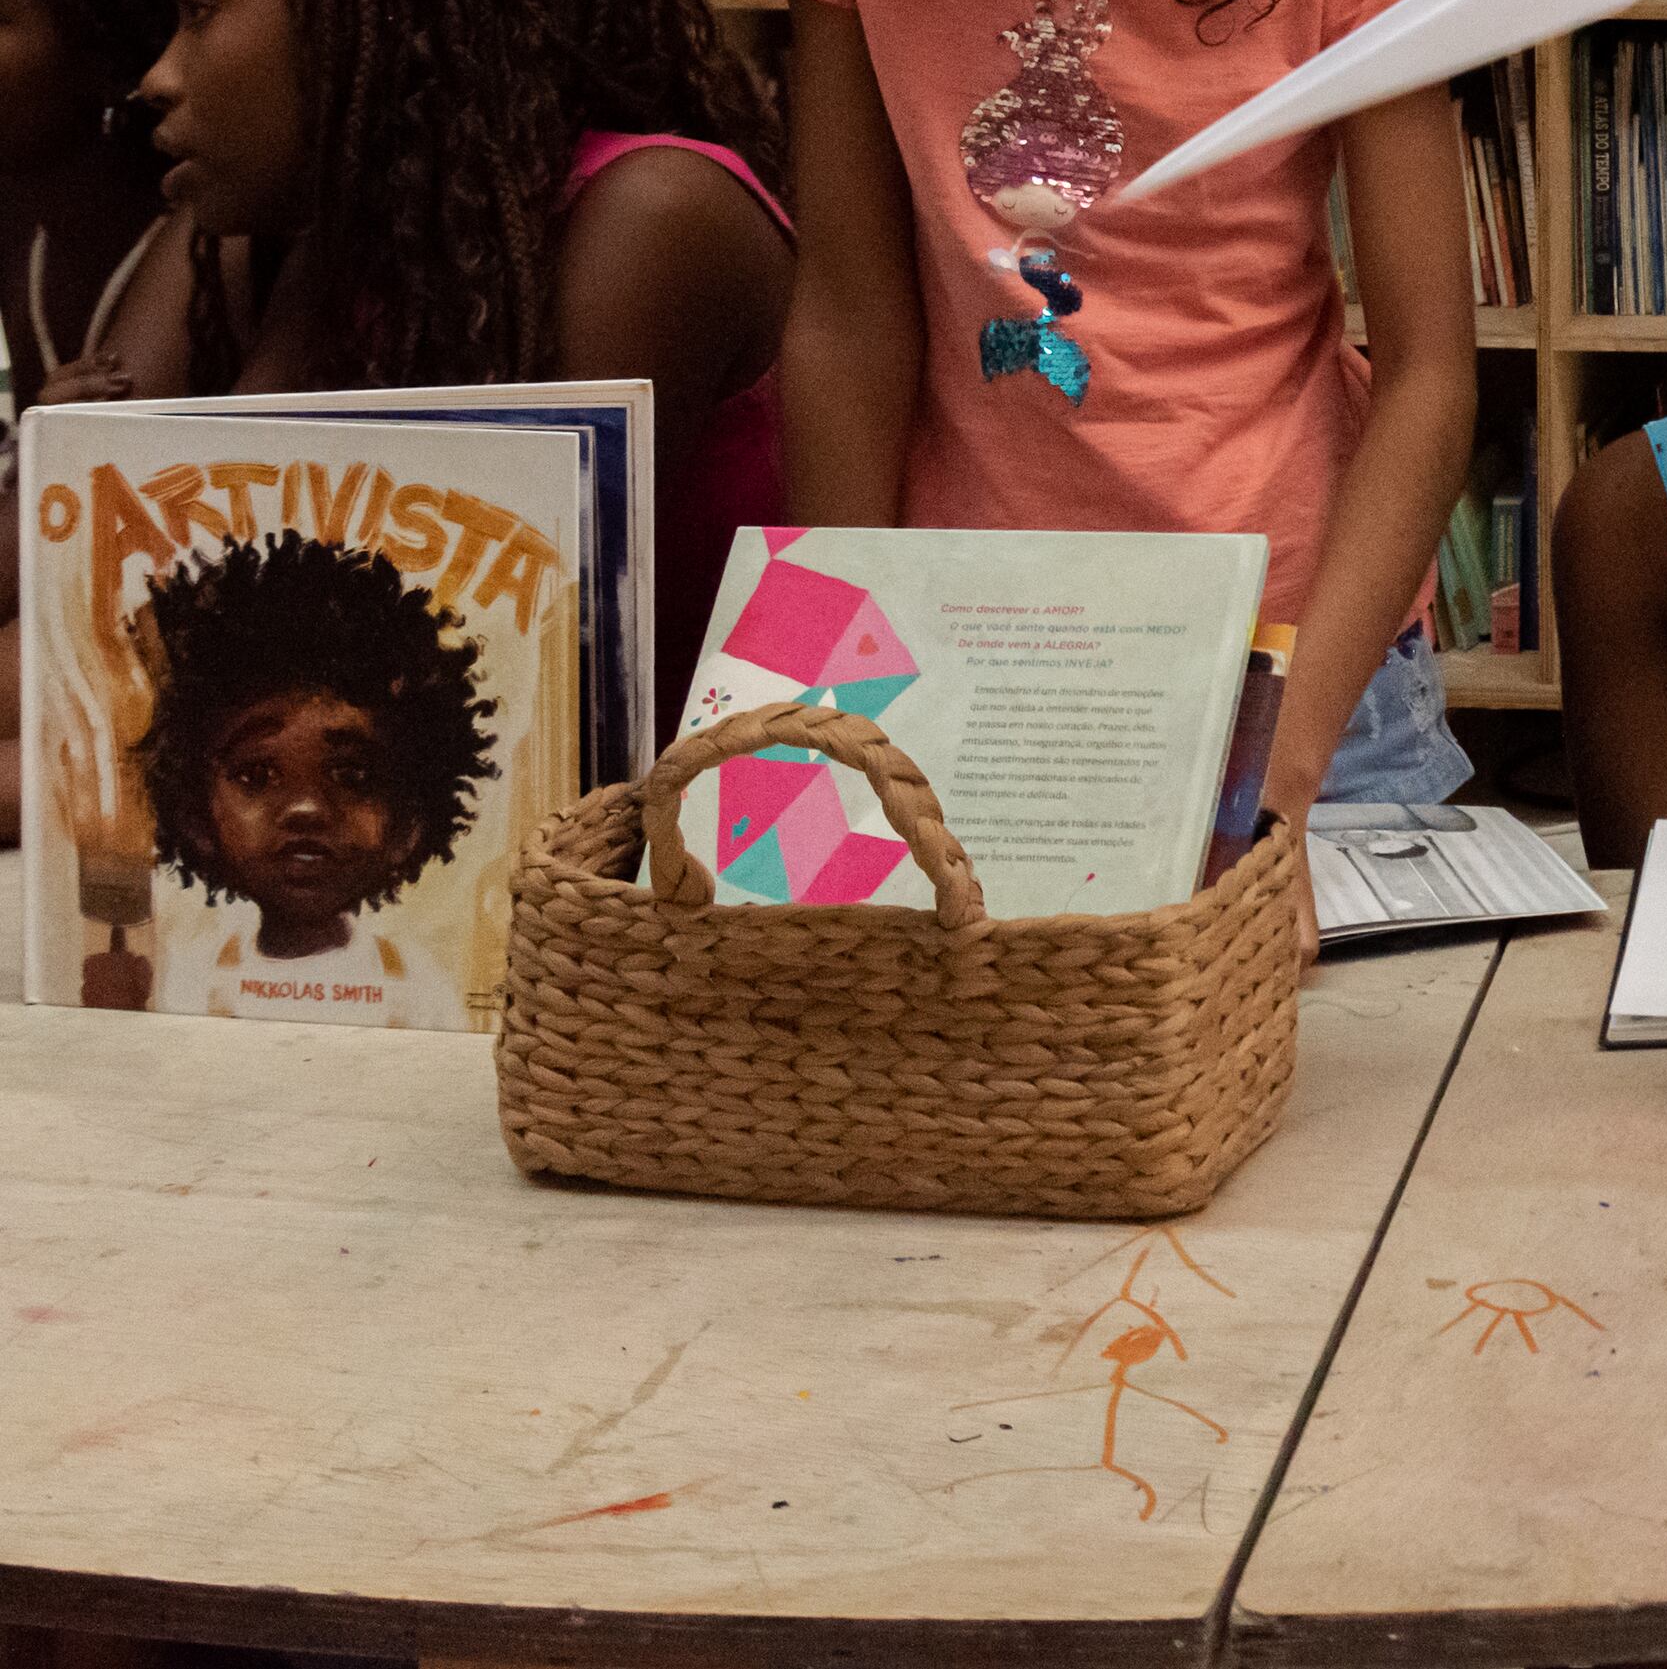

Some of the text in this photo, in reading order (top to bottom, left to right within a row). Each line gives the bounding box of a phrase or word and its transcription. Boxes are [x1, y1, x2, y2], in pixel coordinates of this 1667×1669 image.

[1595, 96, 1609, 131] ATLAS
[1595, 134, 1609, 150] DO
[1595, 153, 1610, 191] TEMPO
[39, 460, 560, 634] O ARTIVISTA
[941, 604, 973, 614] Como
[976, 605, 1030, 614] descrever
[1044, 606, 1085, 615] AMOR?
[962, 623, 982, 632] que
[987, 621, 1012, 632] você
[1016, 623, 1044, 632] sente
[1048, 623, 1089, 634] quando
[1093, 623, 1116, 633] está
[1120, 626, 1143, 634] com
[1147, 625, 1187, 635] MEDO?
[958, 639, 973, 648] De
[976, 639, 1004, 649] onde
[1008, 641, 1031, 649] vem
[1044, 640, 1101, 650] ALEGRIA?
[966, 657, 1114, 668] Por que sentimos INVEJA?
[241, 977, 383, 1004] NIKKOLAS SMITH
